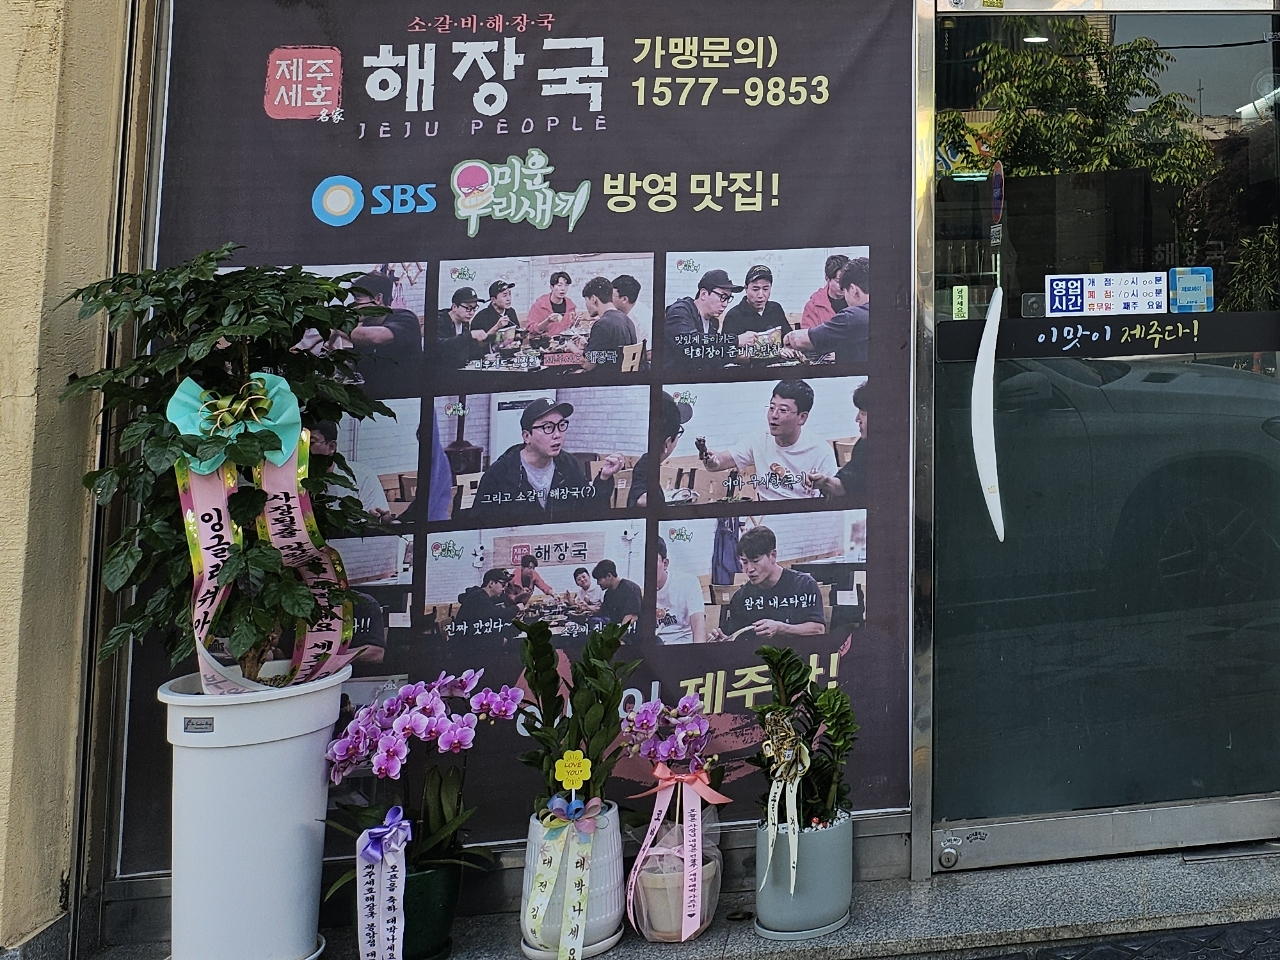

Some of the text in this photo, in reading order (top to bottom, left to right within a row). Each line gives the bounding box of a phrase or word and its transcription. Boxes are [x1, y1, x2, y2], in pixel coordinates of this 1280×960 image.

[634, 35, 778, 69] 가맹문의)
[275, 58, 334, 81] 제주
[362, 36, 609, 117] 해장국
[273, 84, 334, 107] 세호
[631, 77, 830, 109] 1577-9853
[316, 107, 345, 124] 名家
[358, 115, 607, 140] JEJU PEOPLE
[492, 149, 554, 192] 미운
[371, 183, 437, 215] SBS
[604, 171, 779, 213] 방영 맛집!
[1053, 280, 1082, 296] 영업
[1087, 278, 1096, 287] 개
[956, 288, 964, 313] 당기세요
[1053, 296, 1083, 311] 시간
[1147, 300, 1163, 310] 요일
[1037, 319, 1199, 352] 이맛이 제주다!
[480, 485, 597, 505] 그리고 소갈비 해장국(?)
[534, 541, 589, 563] 해장국
[744, 593, 818, 612] 완전 내스타일!!
[445, 620, 469, 637] 진짜
[564, 760, 583, 769] LOVE
